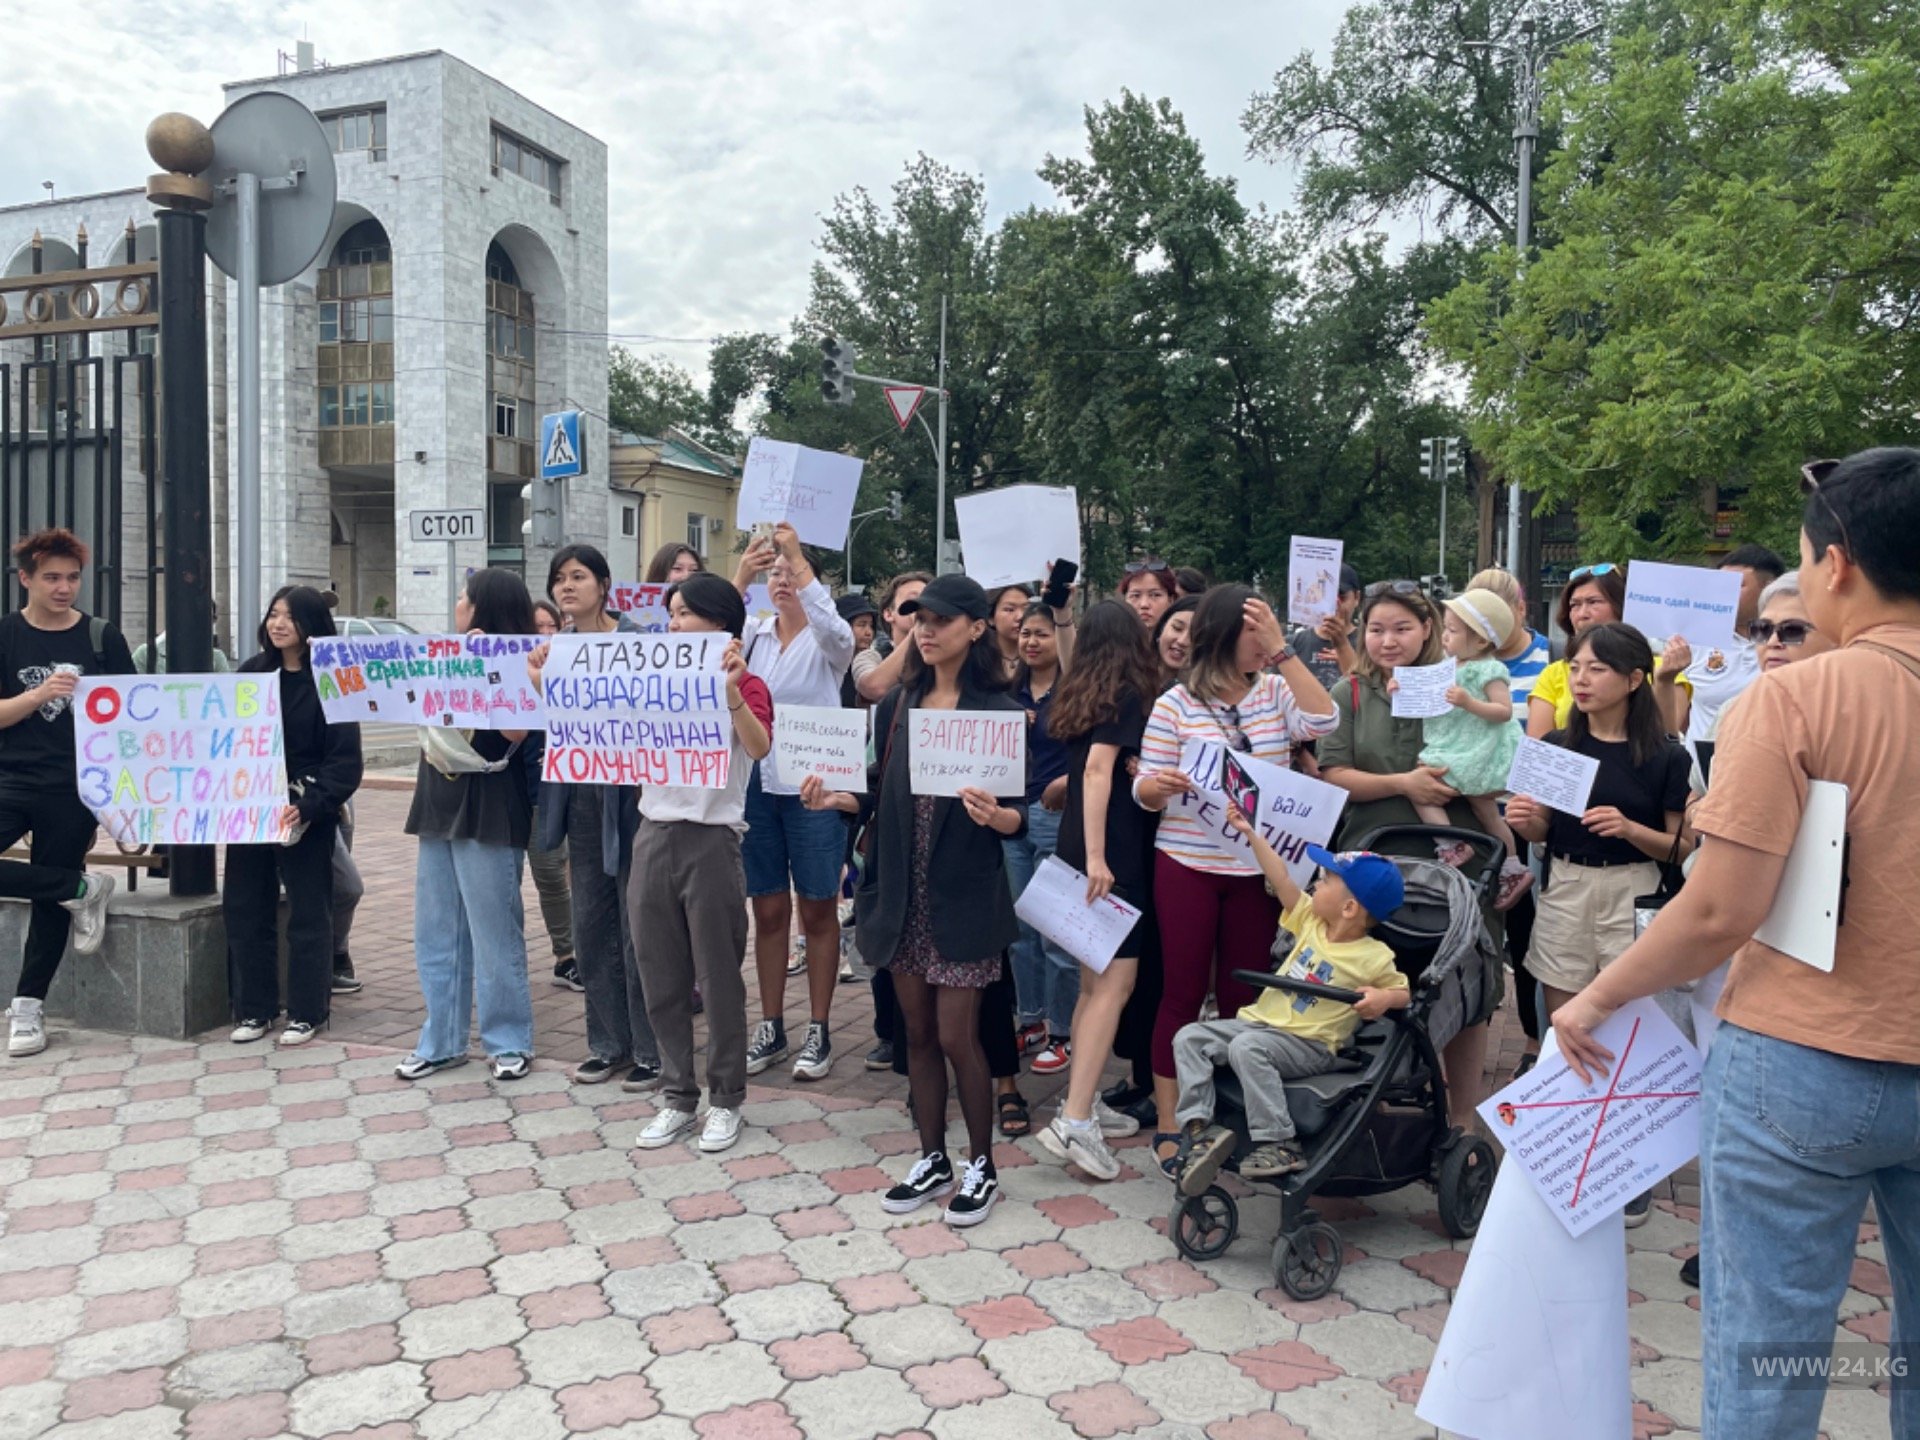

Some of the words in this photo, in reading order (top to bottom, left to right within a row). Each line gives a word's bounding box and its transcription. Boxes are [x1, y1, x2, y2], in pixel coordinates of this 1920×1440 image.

[422, 515, 473, 536] СТОП
[1628, 591, 1662, 605] Атазов
[1665, 597, 1690, 609] сдай
[1693, 602, 1734, 613] мандат
[571, 639, 708, 672] АТАЗОВ!
[85, 680, 278, 724] ОСТАВЬ
[422, 686, 537, 718] ЛОШАДЬ
[545, 674, 719, 712] КЫЗДАРДЫН
[84, 729, 196, 763] СВОИ
[549, 720, 723, 748] УКУКТАРЫНАН
[920, 718, 1022, 760] ЗАПРЕТИТЕ
[546, 748, 670, 785] КОЛУНДУ
[673, 748, 730, 787] ТАРТ!
[1519, 1145, 1532, 1158] Он
[1534, 1115, 1580, 1150] выражает
[1618, 1046, 1682, 1092] большинства
[1569, 1127, 1589, 1145] Мне
[1619, 1099, 1633, 1112] же
[1541, 1154, 1583, 1186] приходят
[1550, 1179, 1573, 1198] того,
[1621, 1132, 1644, 1150] тоже
[1589, 1156, 1638, 1194] просьбой.
